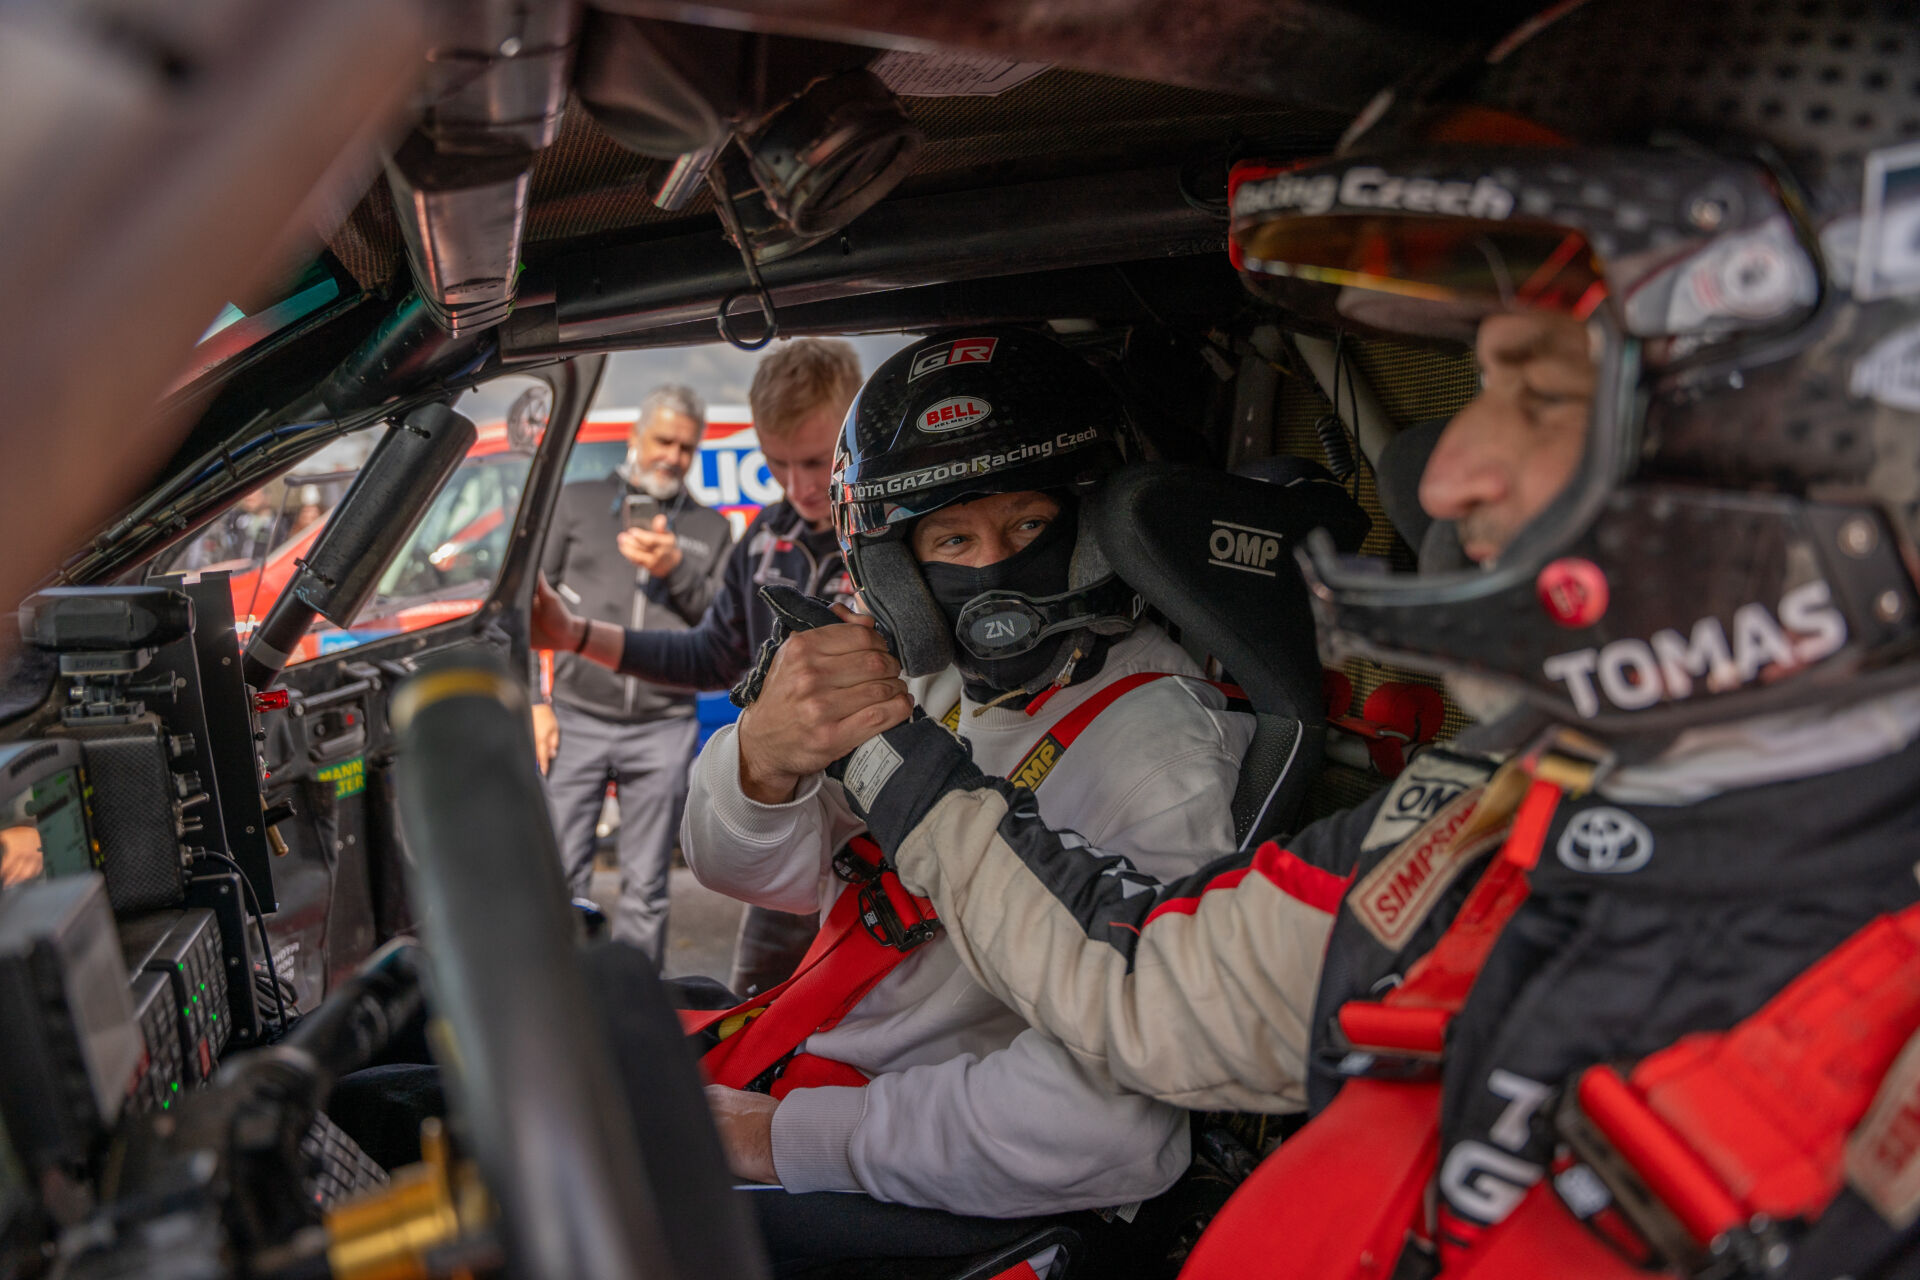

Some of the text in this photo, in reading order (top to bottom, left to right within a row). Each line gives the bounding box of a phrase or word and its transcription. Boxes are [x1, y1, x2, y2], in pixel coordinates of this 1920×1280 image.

[1339, 166, 1515, 222] Czech
[912, 345, 991, 376] GR
[925, 402, 982, 426] BELL
[1055, 426, 1098, 449] Czech
[1209, 528, 1279, 569] OMP
[1543, 578, 1848, 719] TOMAS
[318, 759, 364, 782] MANN
